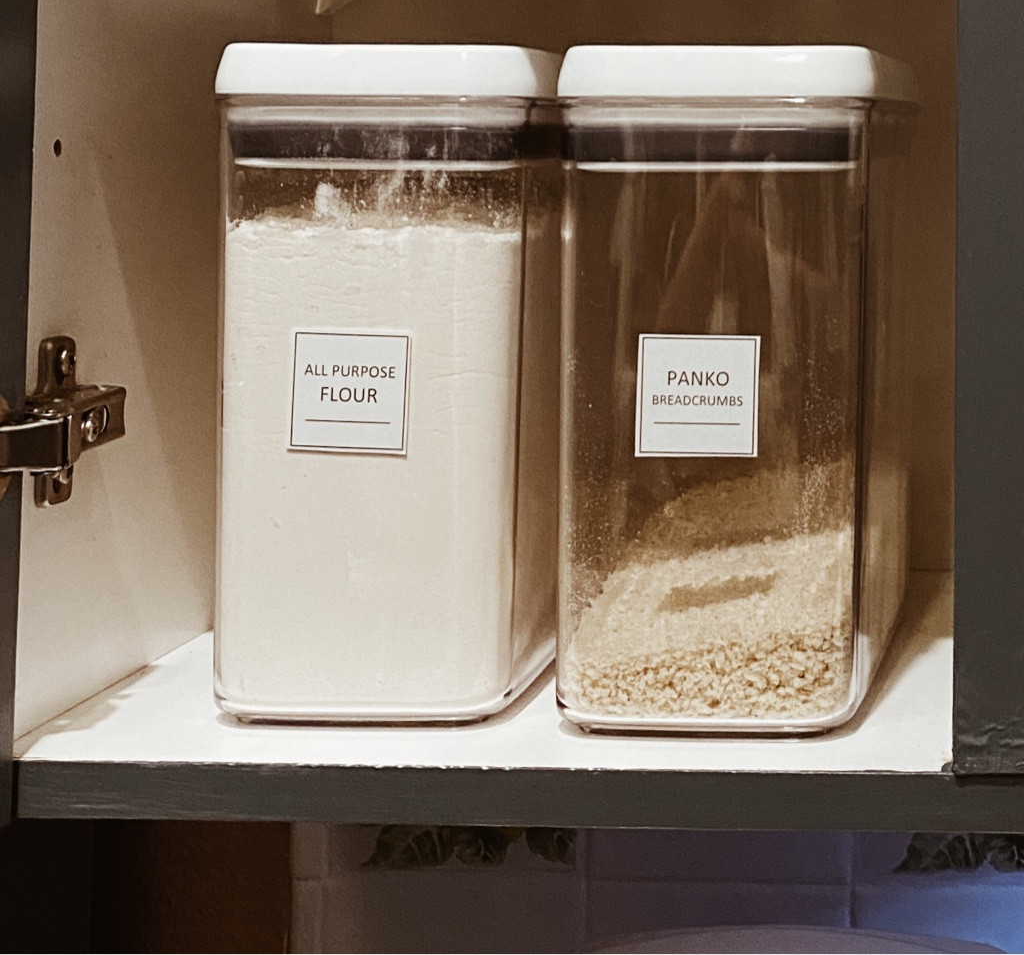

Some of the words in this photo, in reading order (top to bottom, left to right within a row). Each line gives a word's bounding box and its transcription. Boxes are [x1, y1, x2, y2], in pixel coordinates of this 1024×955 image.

[303, 362, 330, 377] ALL
[331, 364, 396, 380] PURPOSE
[667, 370, 730, 387] PANKO
[320, 386, 378, 404] FLOUR
[651, 394, 744, 407] BREADCRUMBS
